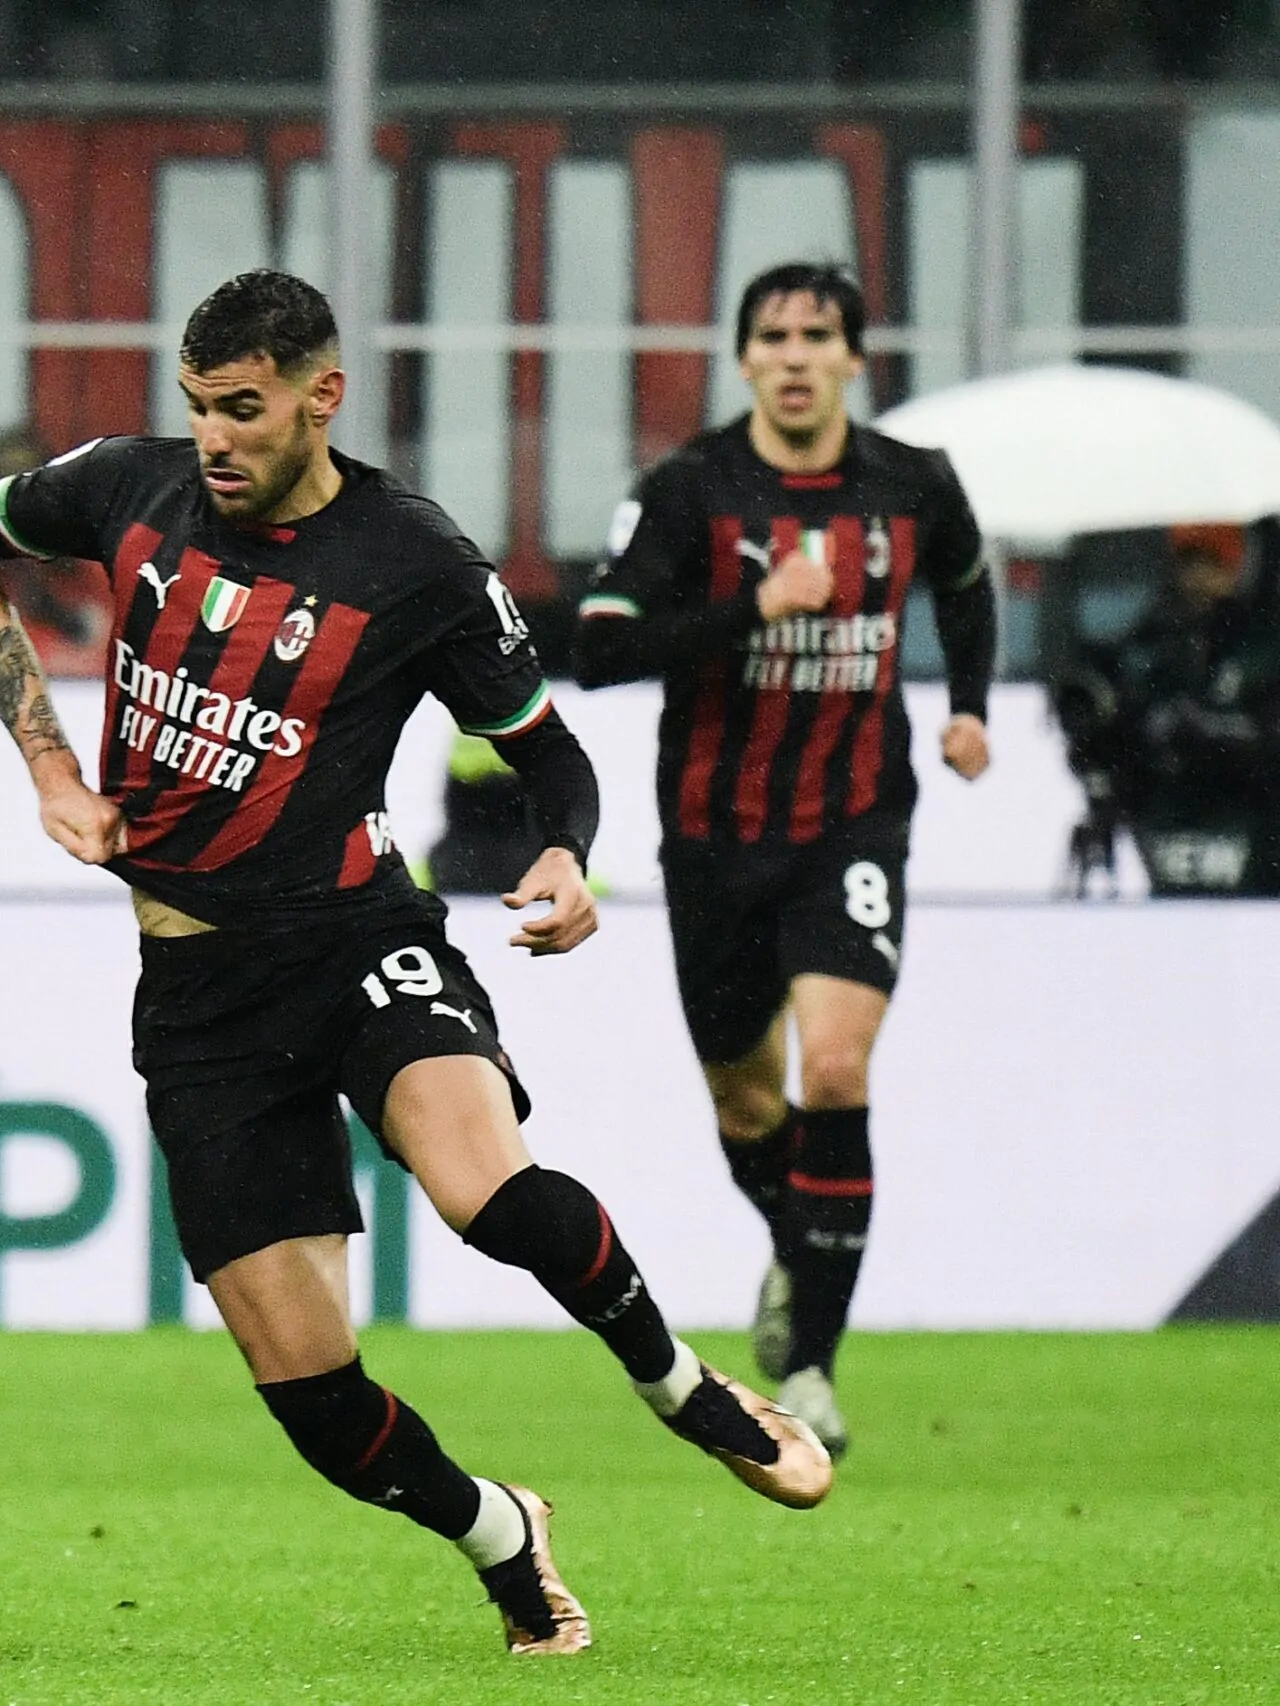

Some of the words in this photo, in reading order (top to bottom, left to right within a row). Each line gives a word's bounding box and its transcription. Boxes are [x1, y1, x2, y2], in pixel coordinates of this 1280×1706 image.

[114, 638, 306, 758] Emirates
[119, 704, 157, 752] FLY
[152, 724, 257, 793] BETTER
[843, 861, 892, 928] 8
[361, 945, 444, 1009] 19
